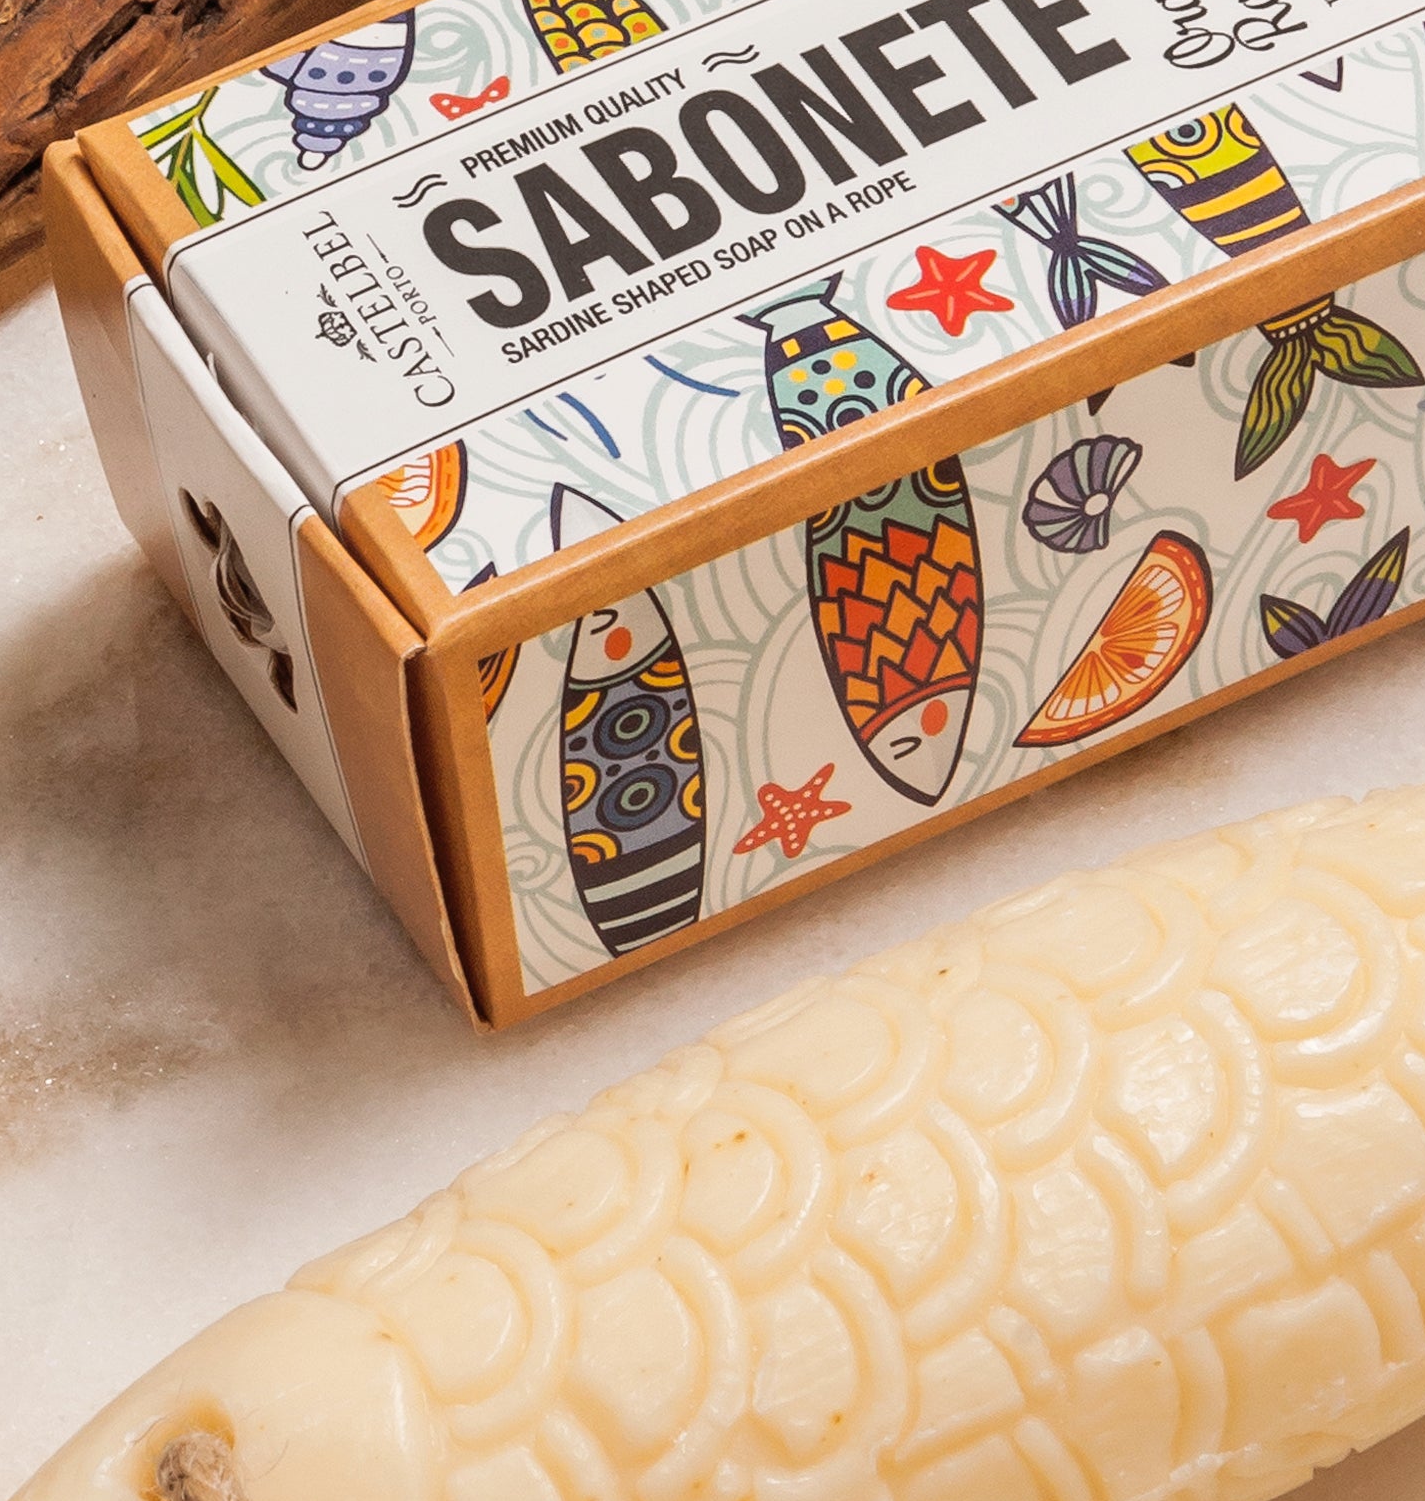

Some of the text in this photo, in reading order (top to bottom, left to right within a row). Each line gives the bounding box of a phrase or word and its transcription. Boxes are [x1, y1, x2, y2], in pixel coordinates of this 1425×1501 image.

[460, 69, 687, 179] PREMIUM QUALITY
[302, 210, 456, 408] CASTELBEL
[391, 266, 439, 326] PORTO
[500, 170, 917, 364] SARDINE SHAPED SOAP ON A ROPE
